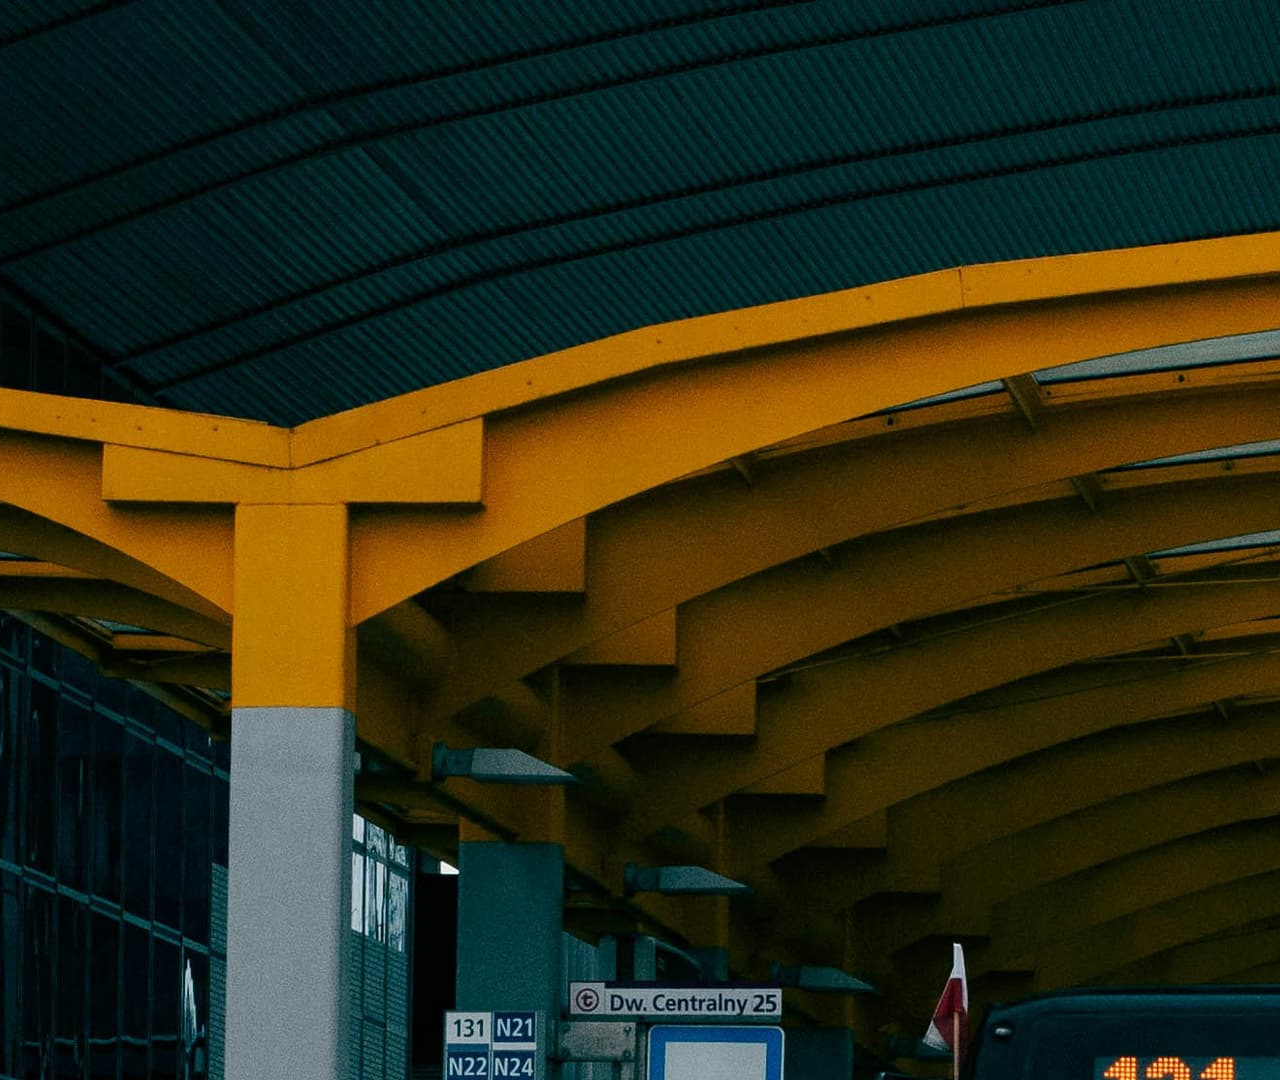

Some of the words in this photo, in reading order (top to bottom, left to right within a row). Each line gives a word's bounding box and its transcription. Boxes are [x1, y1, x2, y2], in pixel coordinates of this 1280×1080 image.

[610, 994, 647, 1012] Dw.
[652, 993, 748, 1015] Centralny
[753, 994, 777, 1012] 25
[454, 1018, 484, 1038] 131
[496, 1017, 533, 1037] N21
[448, 1056, 488, 1077] N22
[494, 1057, 533, 1078] N24
